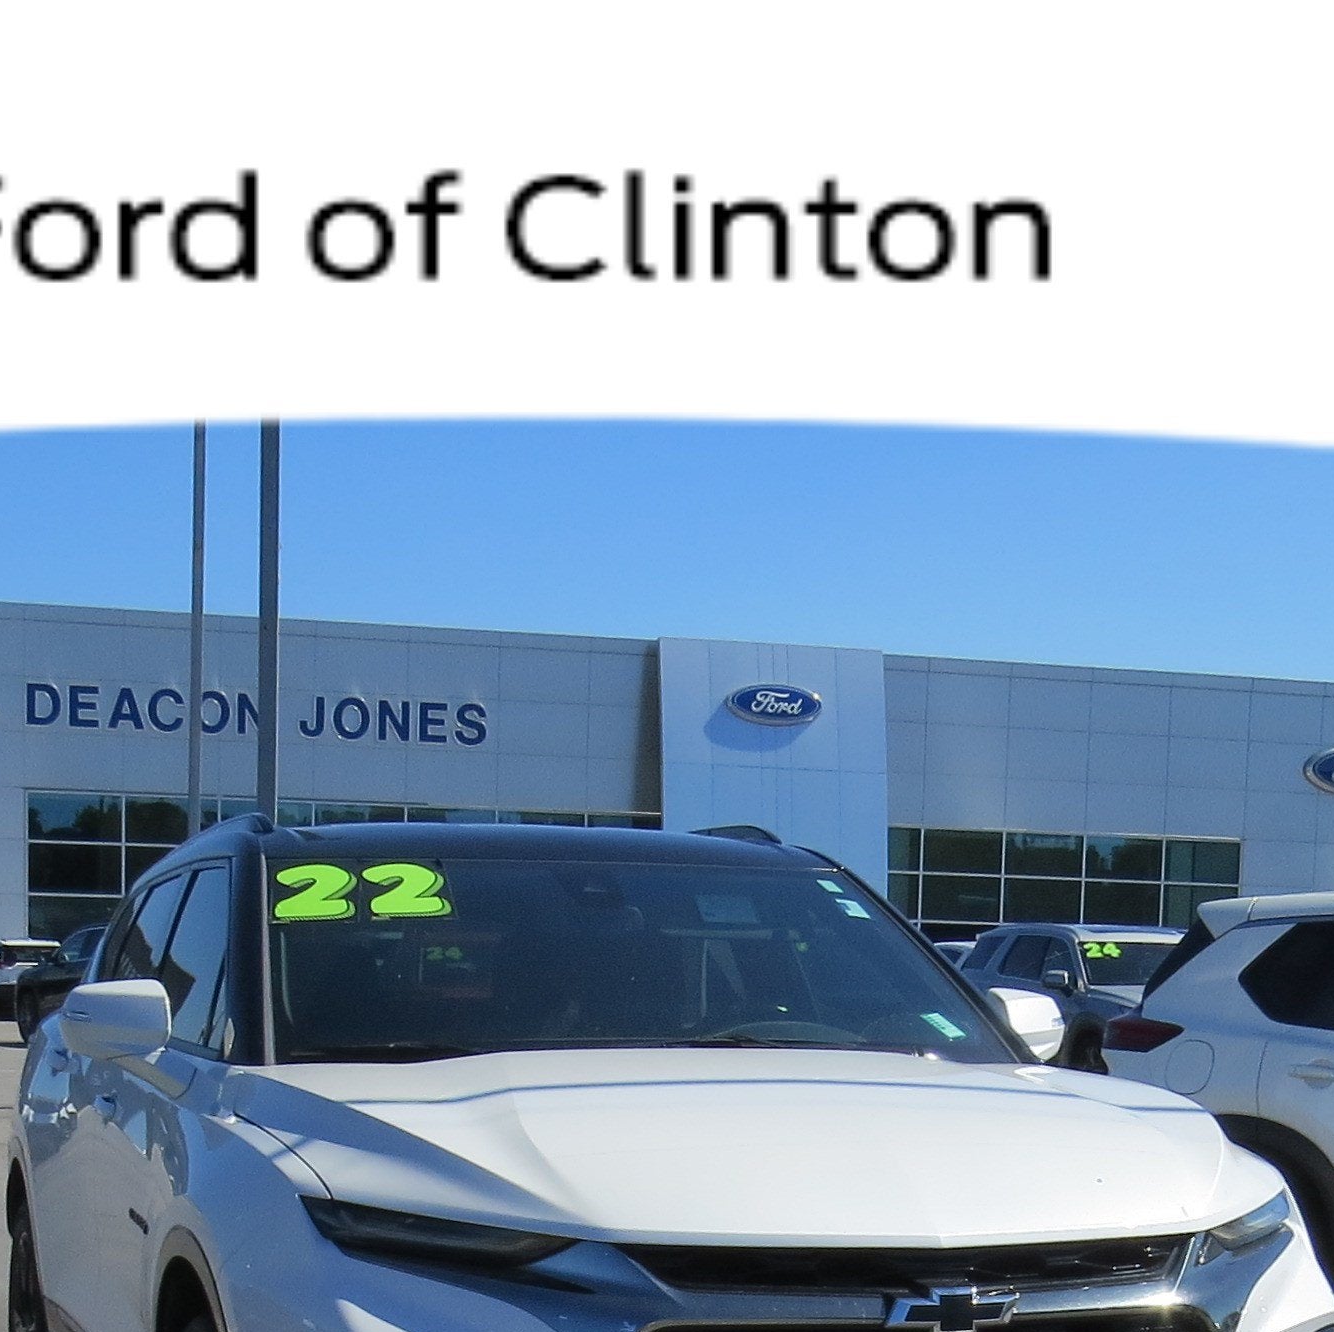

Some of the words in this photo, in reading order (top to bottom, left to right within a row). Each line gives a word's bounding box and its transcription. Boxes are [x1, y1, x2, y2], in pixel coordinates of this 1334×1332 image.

[25, 682, 259, 735] DEACON
[298, 696, 487, 746] JONES
[750, 690, 803, 716] Ford
[273, 861, 453, 923] 22
[1082, 942, 1123, 959] 24
